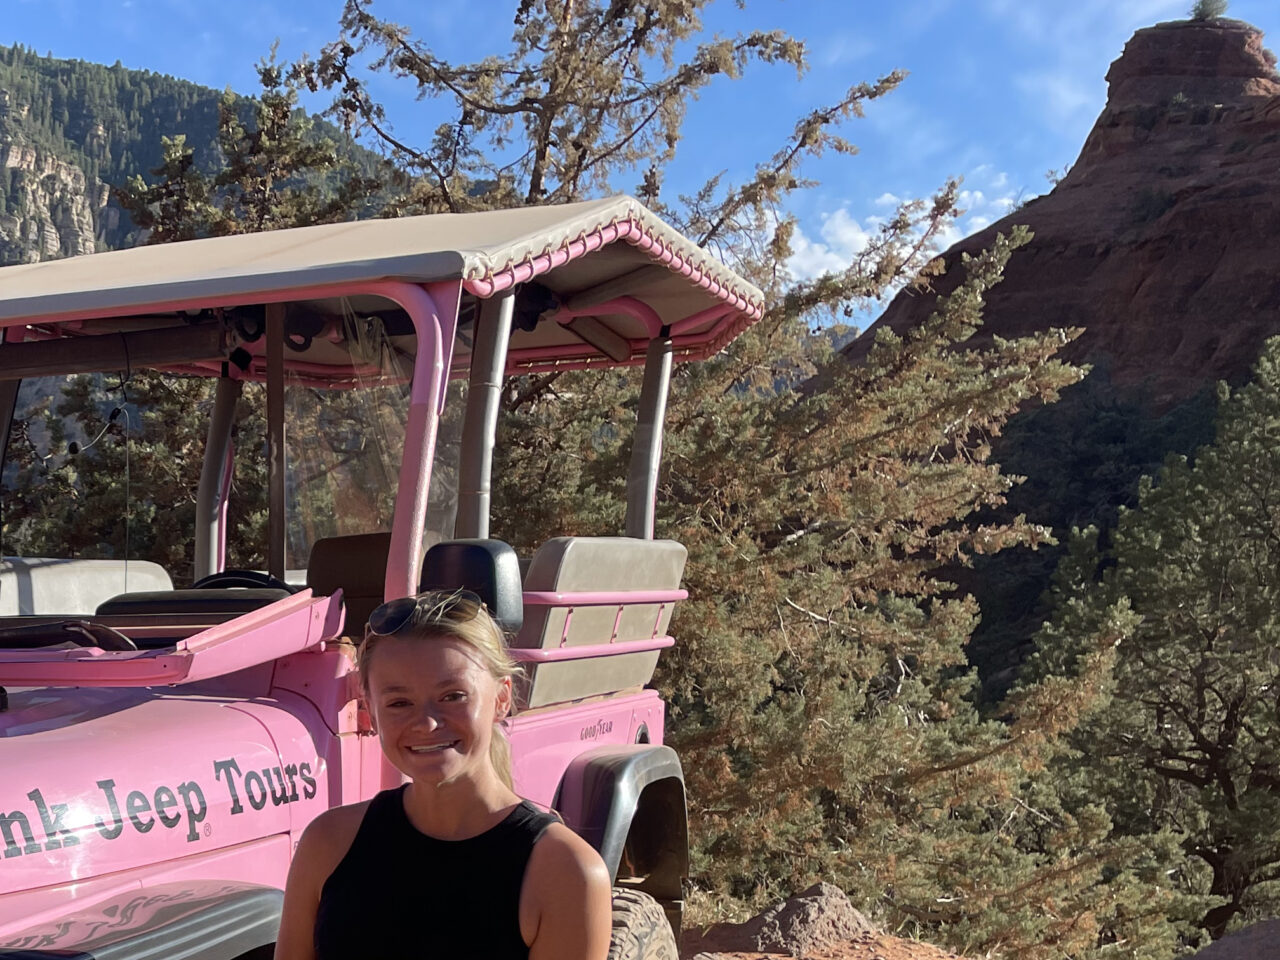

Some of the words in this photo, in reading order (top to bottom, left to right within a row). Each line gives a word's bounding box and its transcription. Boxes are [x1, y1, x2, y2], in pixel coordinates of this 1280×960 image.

[580, 719, 613, 741] GOODYEAR
[95, 779, 208, 842] Jeep
[214, 758, 317, 815] Tours
